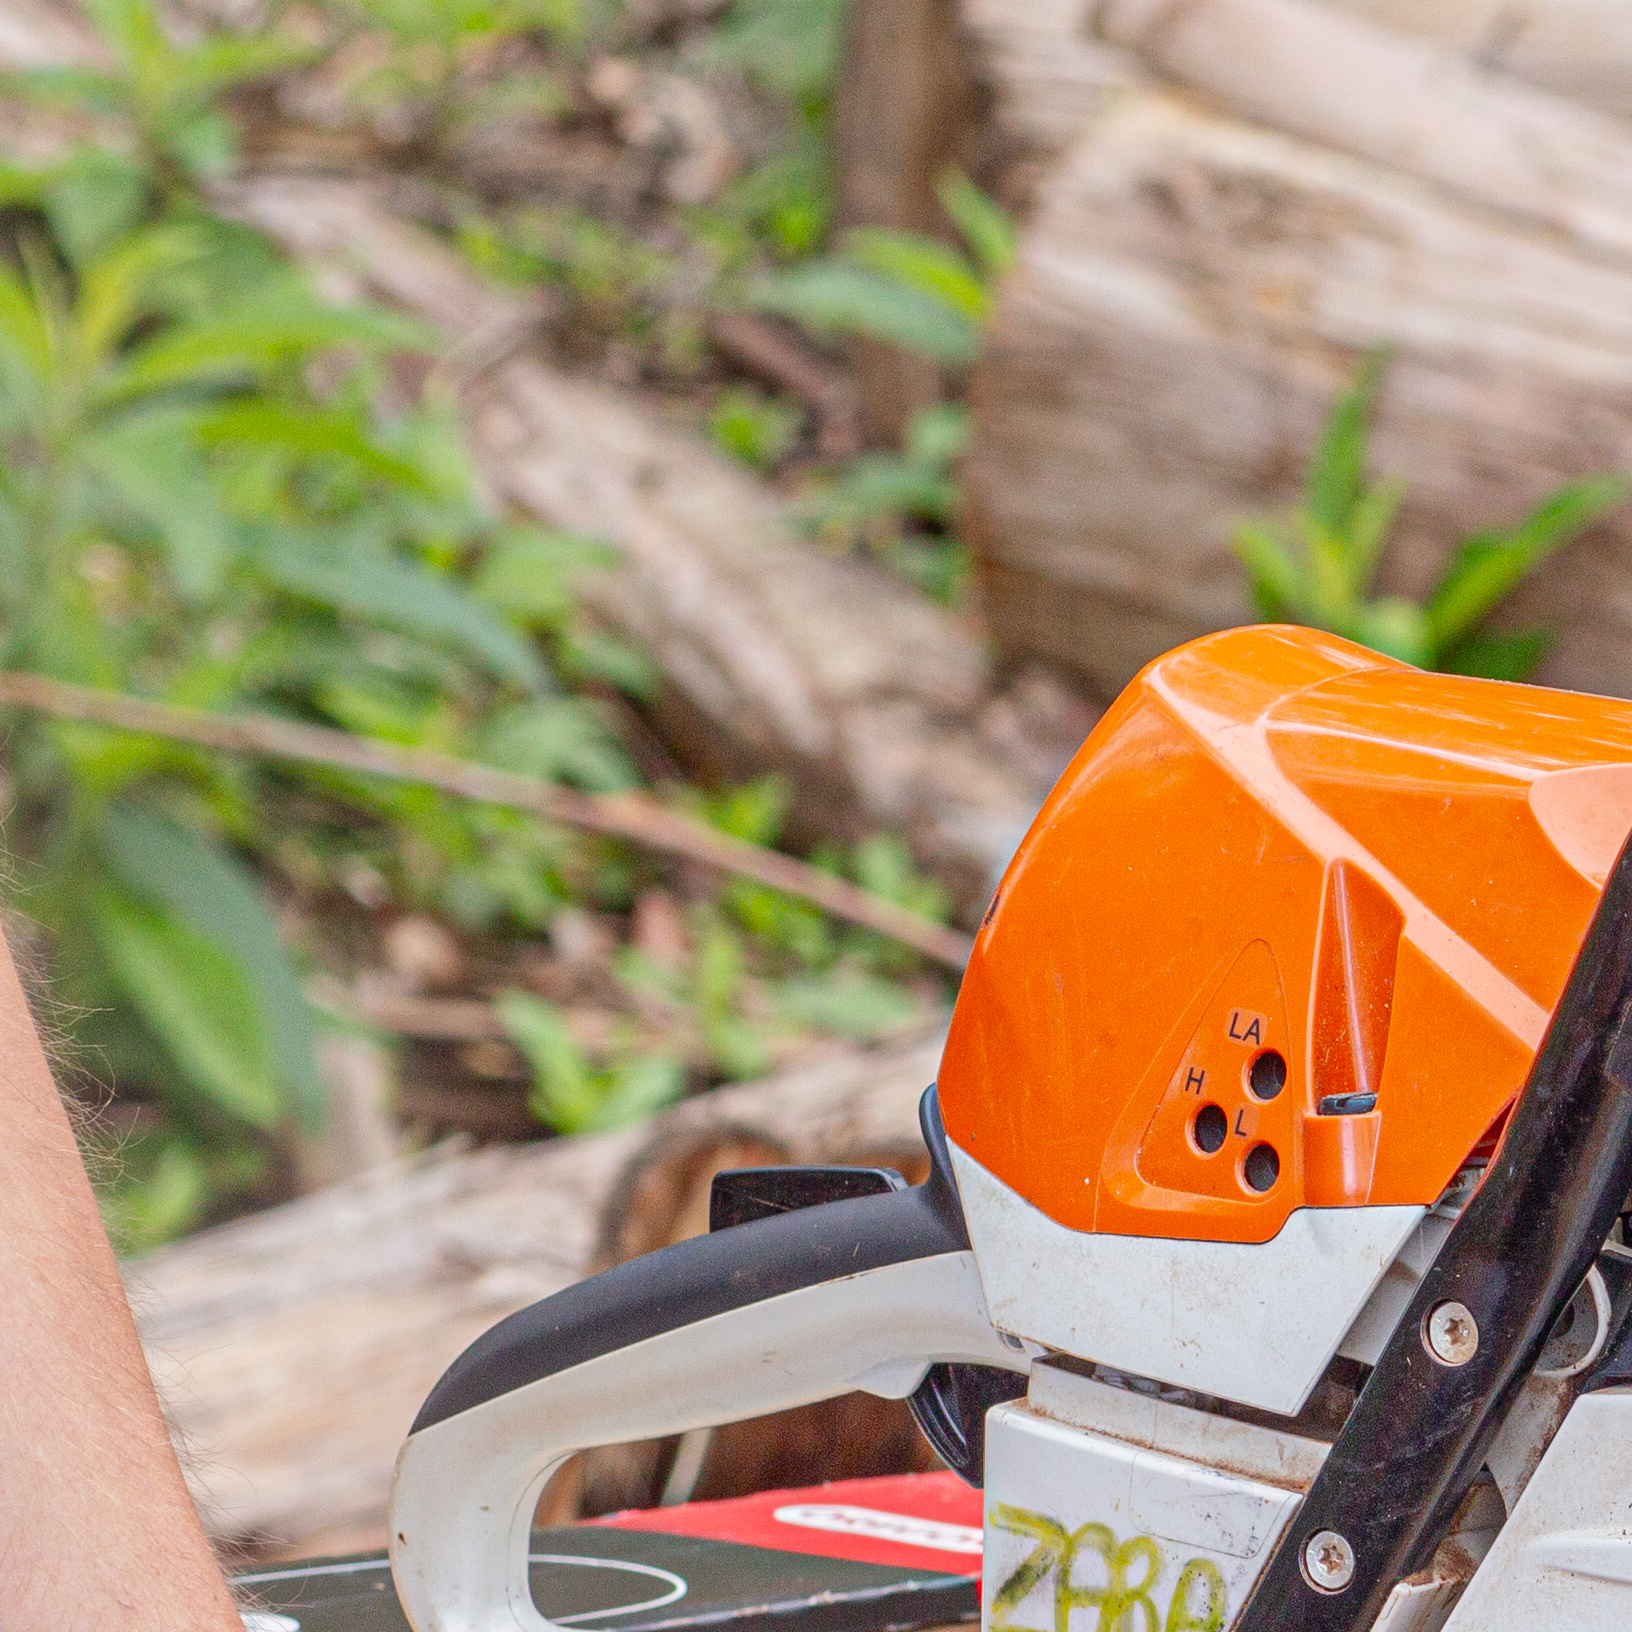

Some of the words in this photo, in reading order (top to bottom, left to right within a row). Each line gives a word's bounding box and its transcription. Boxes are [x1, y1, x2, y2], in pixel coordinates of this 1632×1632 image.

[1228, 1011, 1261, 1046] LA
[1184, 1066, 1205, 1095] H
[1234, 1108, 1247, 1137] L
